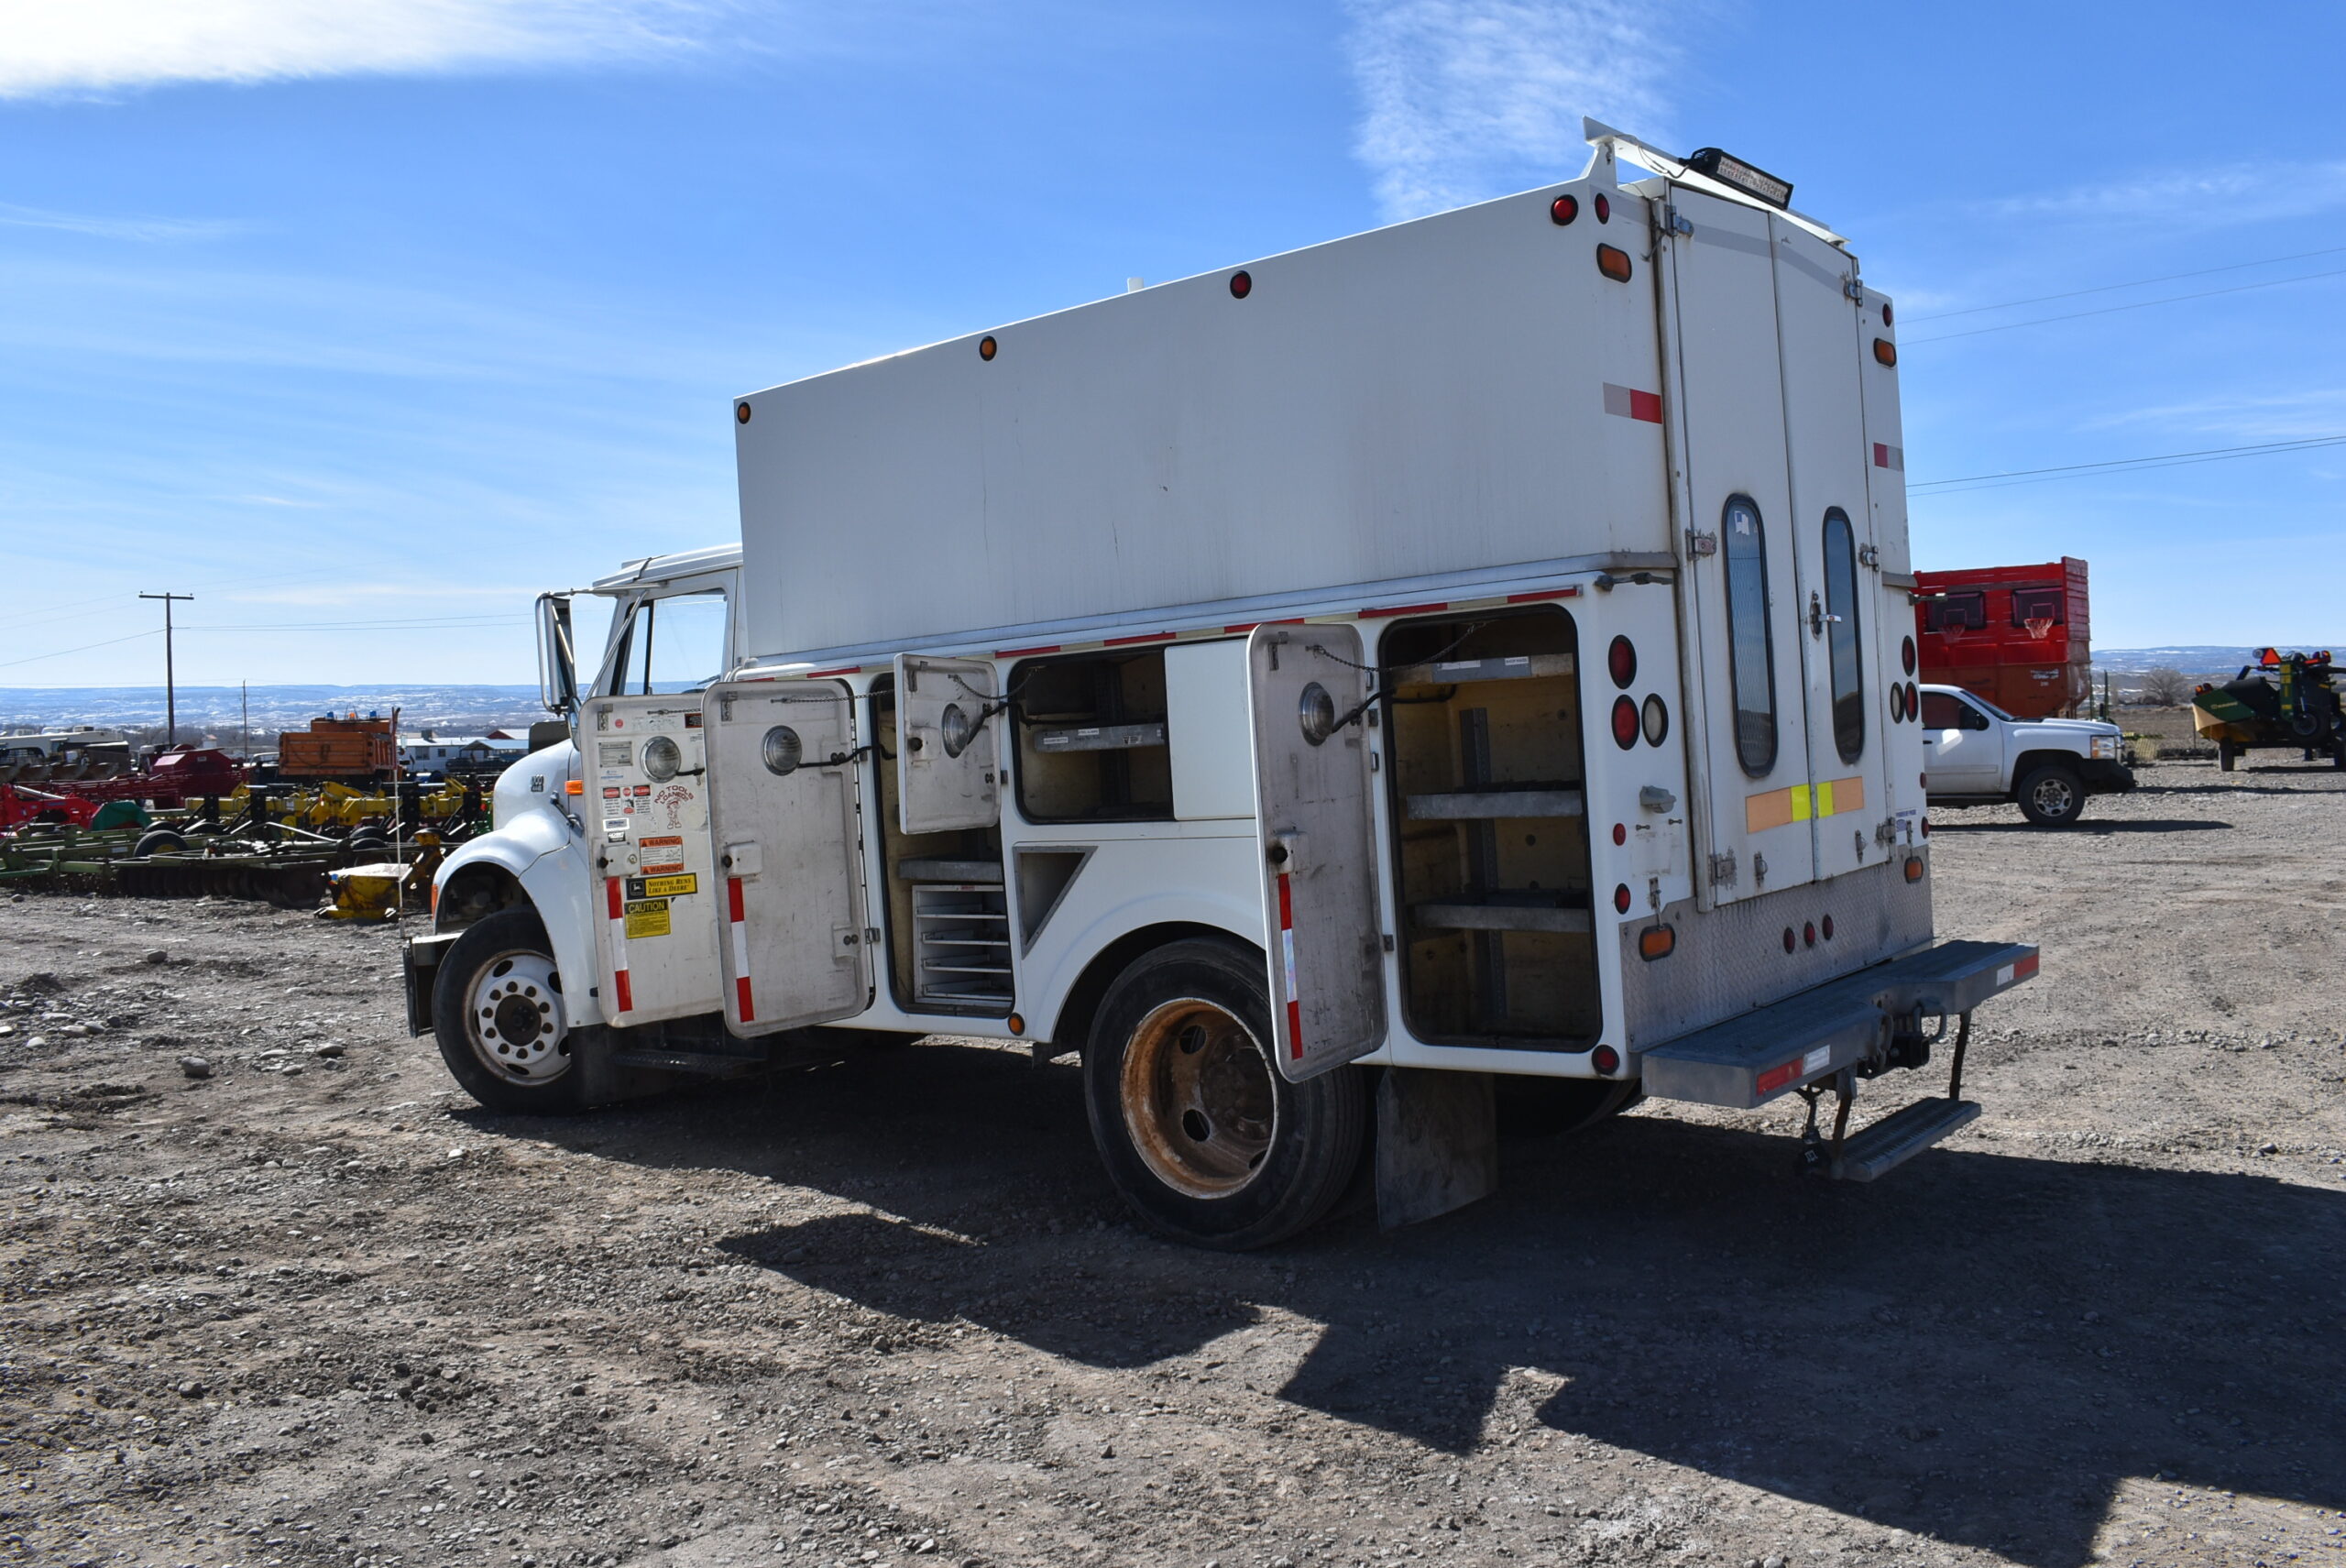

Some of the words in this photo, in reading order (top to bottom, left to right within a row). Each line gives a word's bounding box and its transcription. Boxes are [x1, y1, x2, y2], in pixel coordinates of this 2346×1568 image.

[654, 790, 665, 804] NO
[666, 784, 695, 800] TOOLS
[649, 838, 681, 847] WARNING
[651, 864, 682, 873] WARNING
[628, 901, 664, 914] CAUTION
